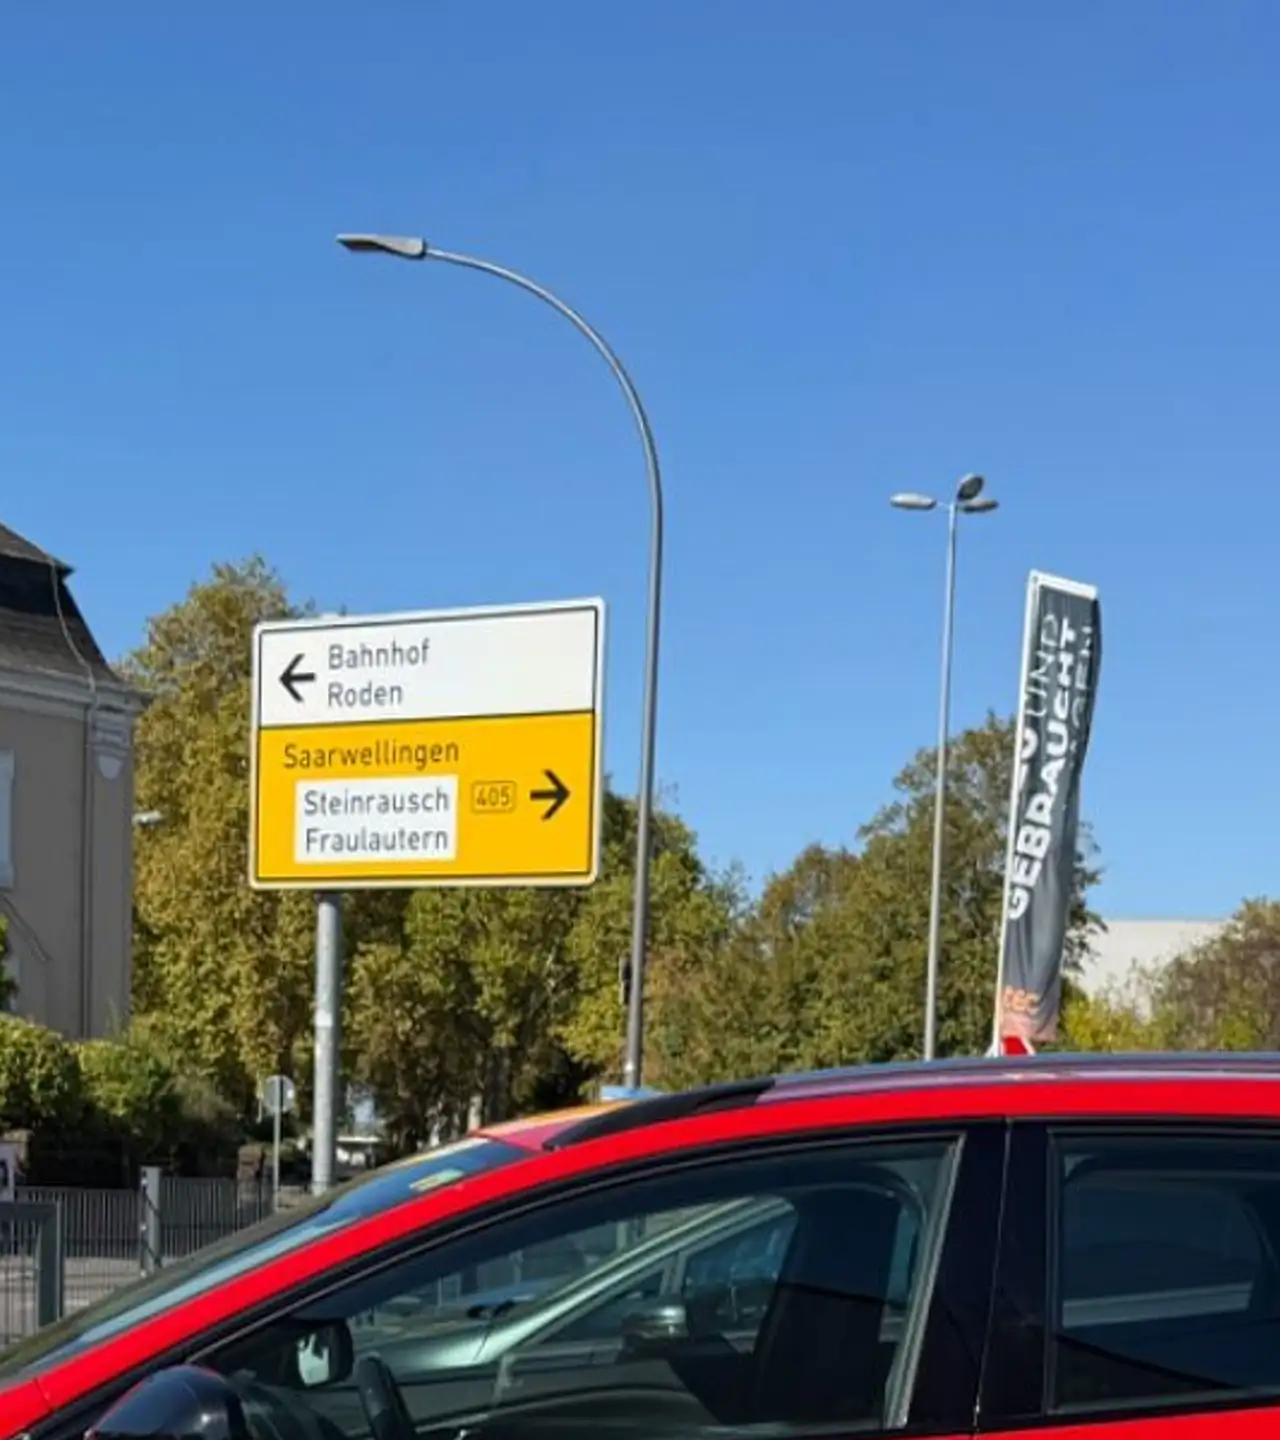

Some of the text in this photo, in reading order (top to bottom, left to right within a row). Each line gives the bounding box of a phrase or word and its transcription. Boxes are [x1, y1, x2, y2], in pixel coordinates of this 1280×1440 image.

[328, 637, 431, 670] Bahnhof
[1024, 613, 1059, 718] UND
[328, 681, 403, 707] Roden
[283, 740, 460, 770] Saarwellingen
[1007, 616, 1077, 920] GEBRAUCHT
[304, 786, 450, 816] Steinrausch
[475, 785, 511, 807] 405
[305, 827, 449, 854] Fraulautern
